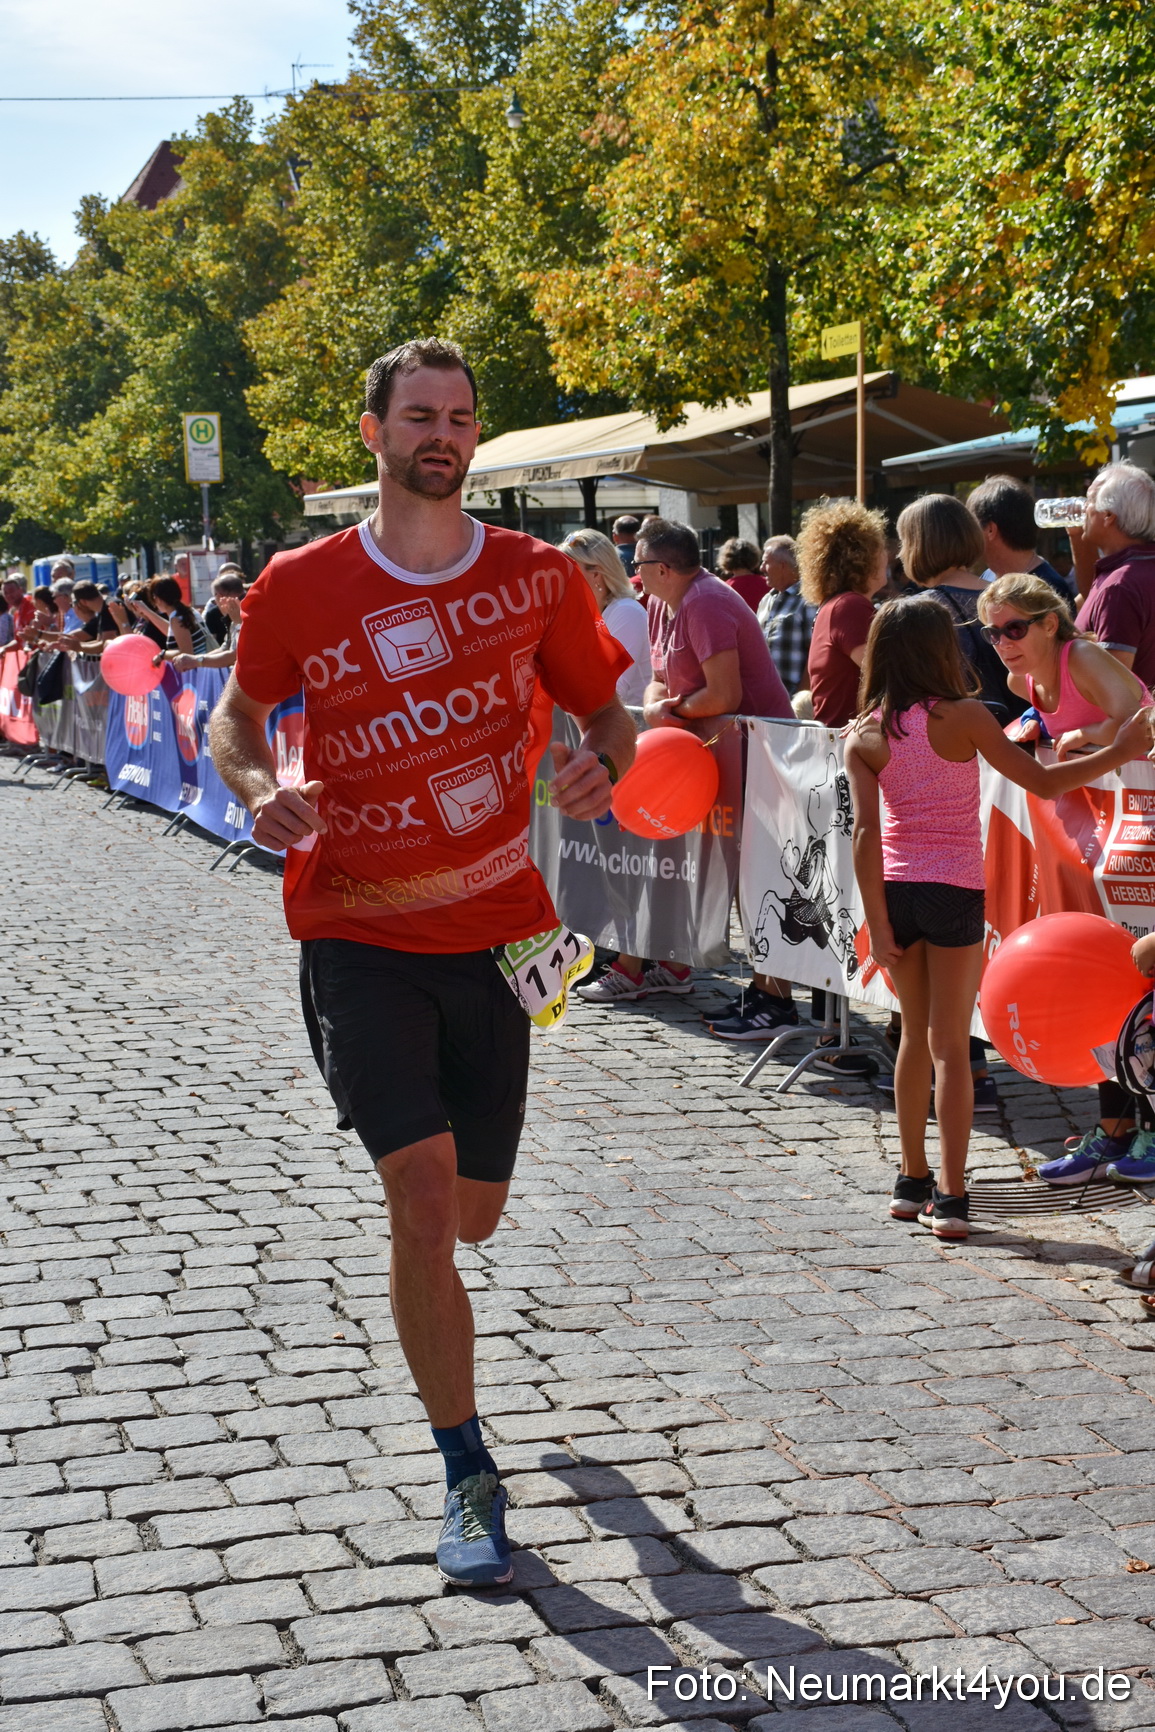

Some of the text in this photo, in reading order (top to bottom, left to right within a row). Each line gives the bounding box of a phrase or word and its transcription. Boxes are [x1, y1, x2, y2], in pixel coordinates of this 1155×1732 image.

[829, 333, 858, 348] Toiletten
[195, 423, 209, 439] H
[368, 604, 431, 633] raumbox
[462, 620, 532, 656] schenken
[386, 744, 449, 775] wohnen
[460, 712, 512, 748] outdoor
[434, 761, 492, 793] raumbox
[1091, 810, 1107, 839] 1929
[332, 866, 459, 909] Team
